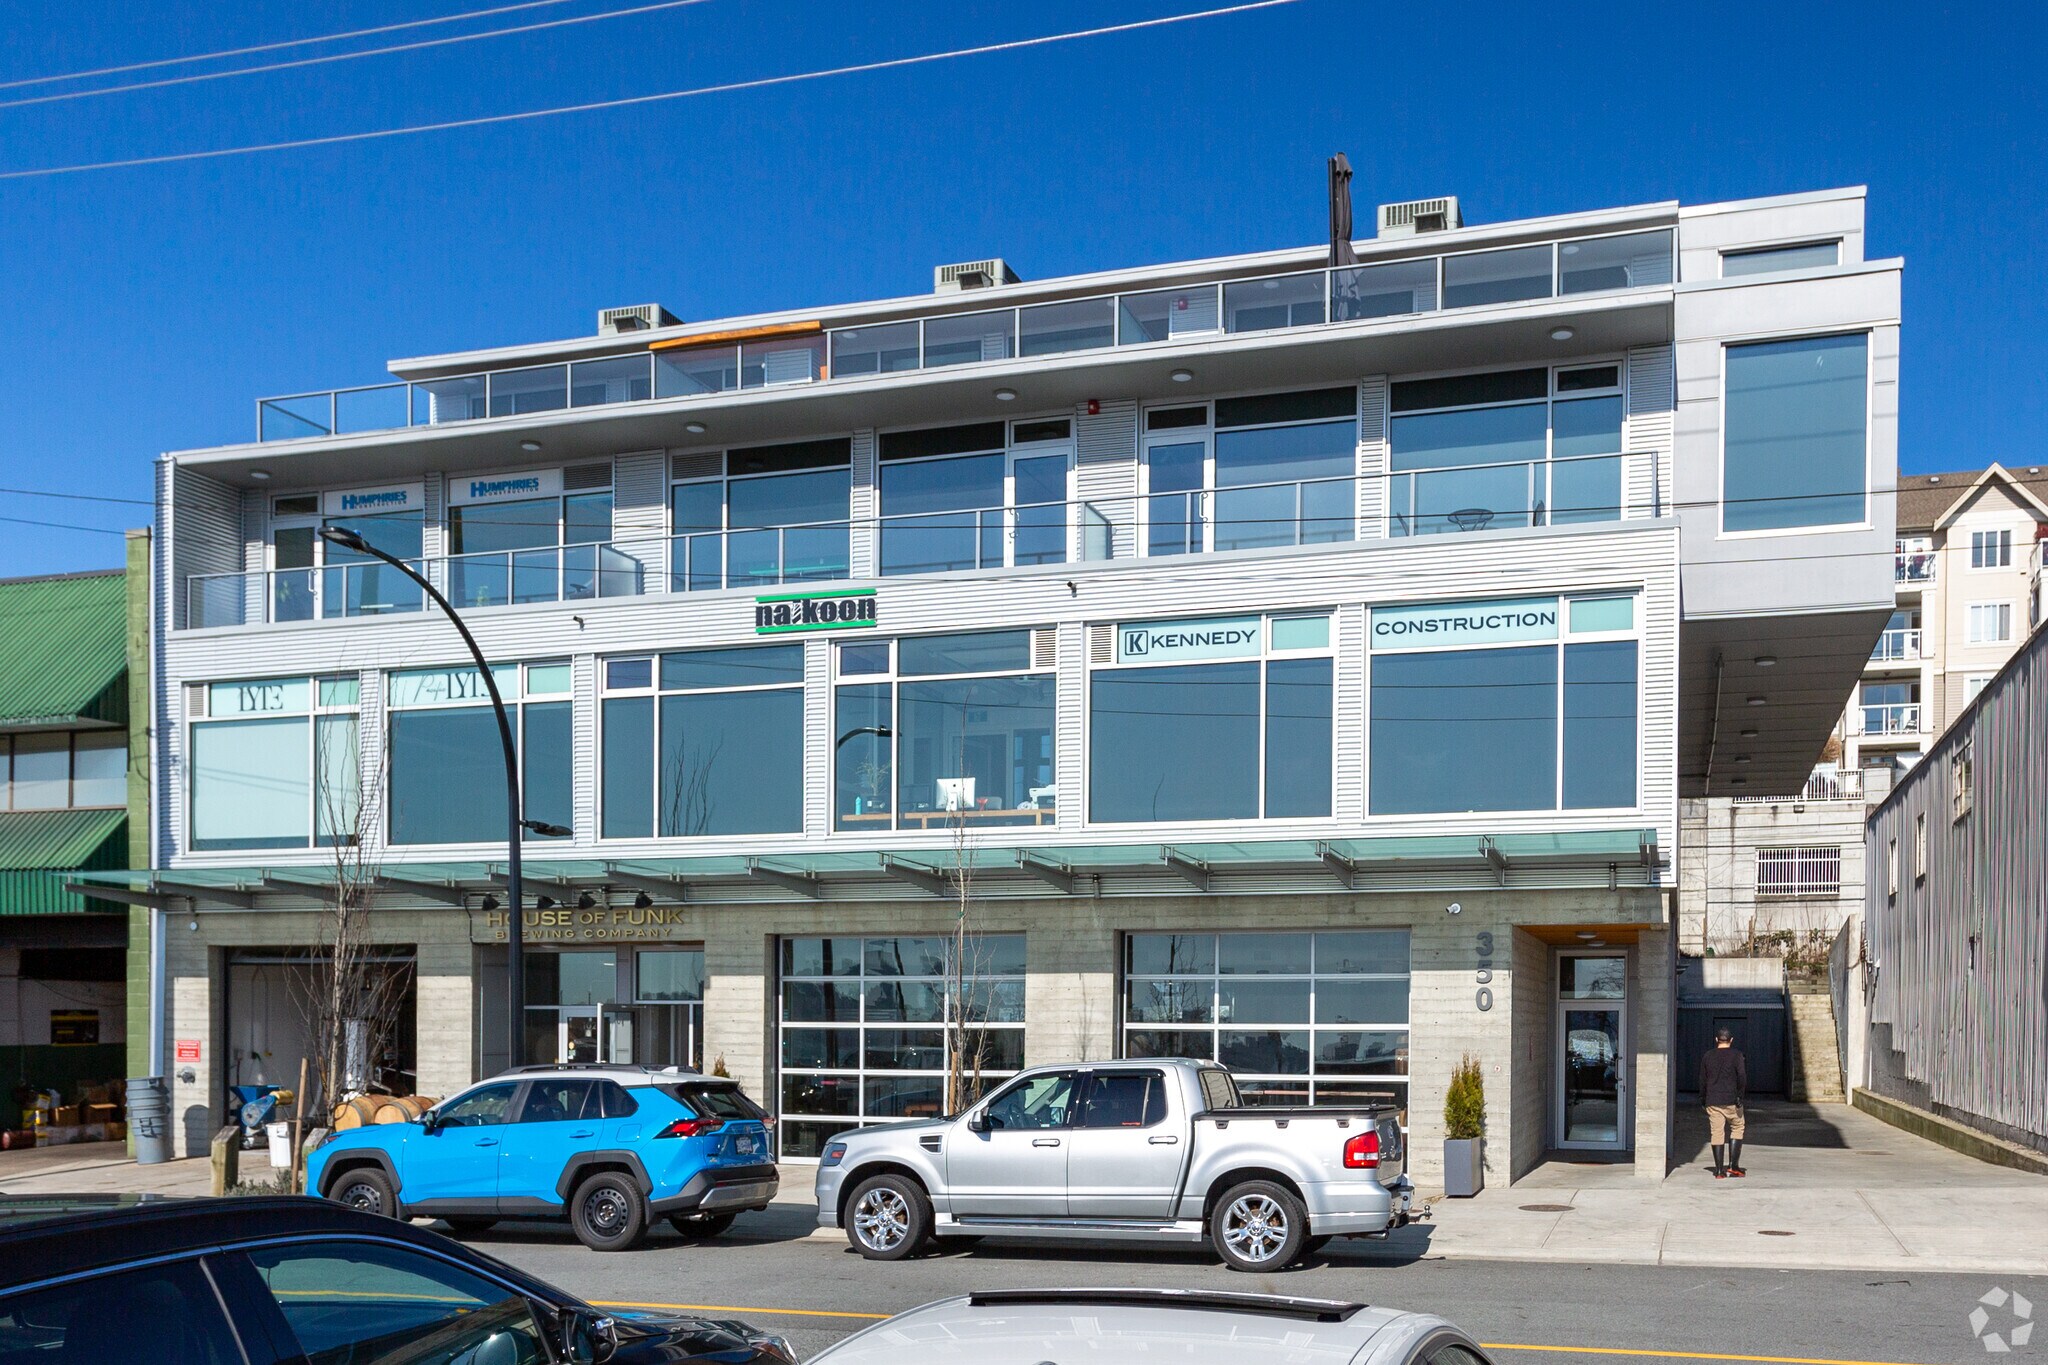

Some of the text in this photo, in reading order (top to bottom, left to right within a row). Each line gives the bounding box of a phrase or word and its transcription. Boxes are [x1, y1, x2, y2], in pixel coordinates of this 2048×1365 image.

[470, 477, 540, 498] HUMPHRIES
[341, 490, 408, 510] HUMPHRIES
[1375, 611, 1556, 636] CONSTRUCTION
[1151, 629, 1257, 649] KENNEDY
[580, 912, 606, 925] OF
[612, 908, 684, 925] FUNK
[495, 927, 672, 939] BEWING COMPANY
[1475, 931, 1494, 1012] 350
